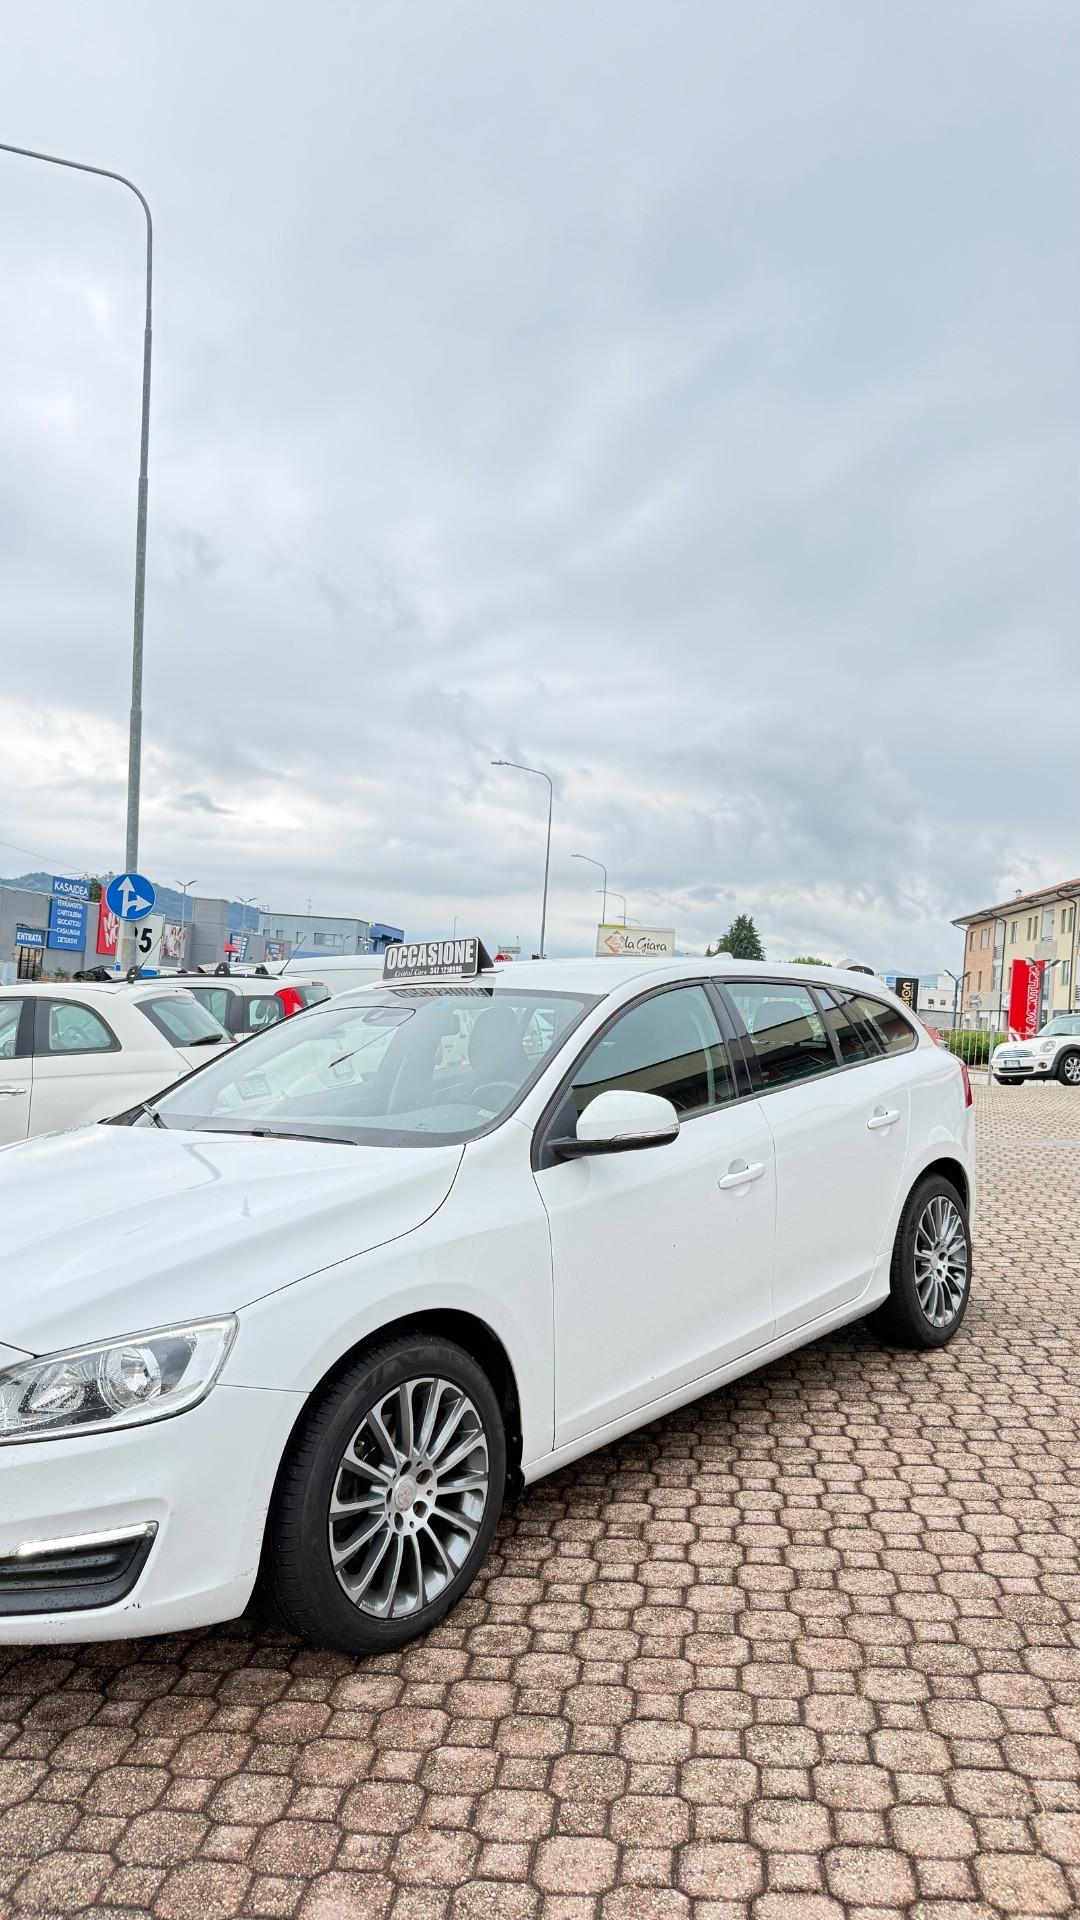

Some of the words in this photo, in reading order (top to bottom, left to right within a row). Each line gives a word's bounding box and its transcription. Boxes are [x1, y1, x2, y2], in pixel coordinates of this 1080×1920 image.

[54, 881, 89, 897] KASAIDEA
[16, 932, 42, 942] ENTRATA
[624, 936, 634, 949] la
[637, 937, 667, 954] Giara
[386, 940, 474, 970] OCCASIONE
